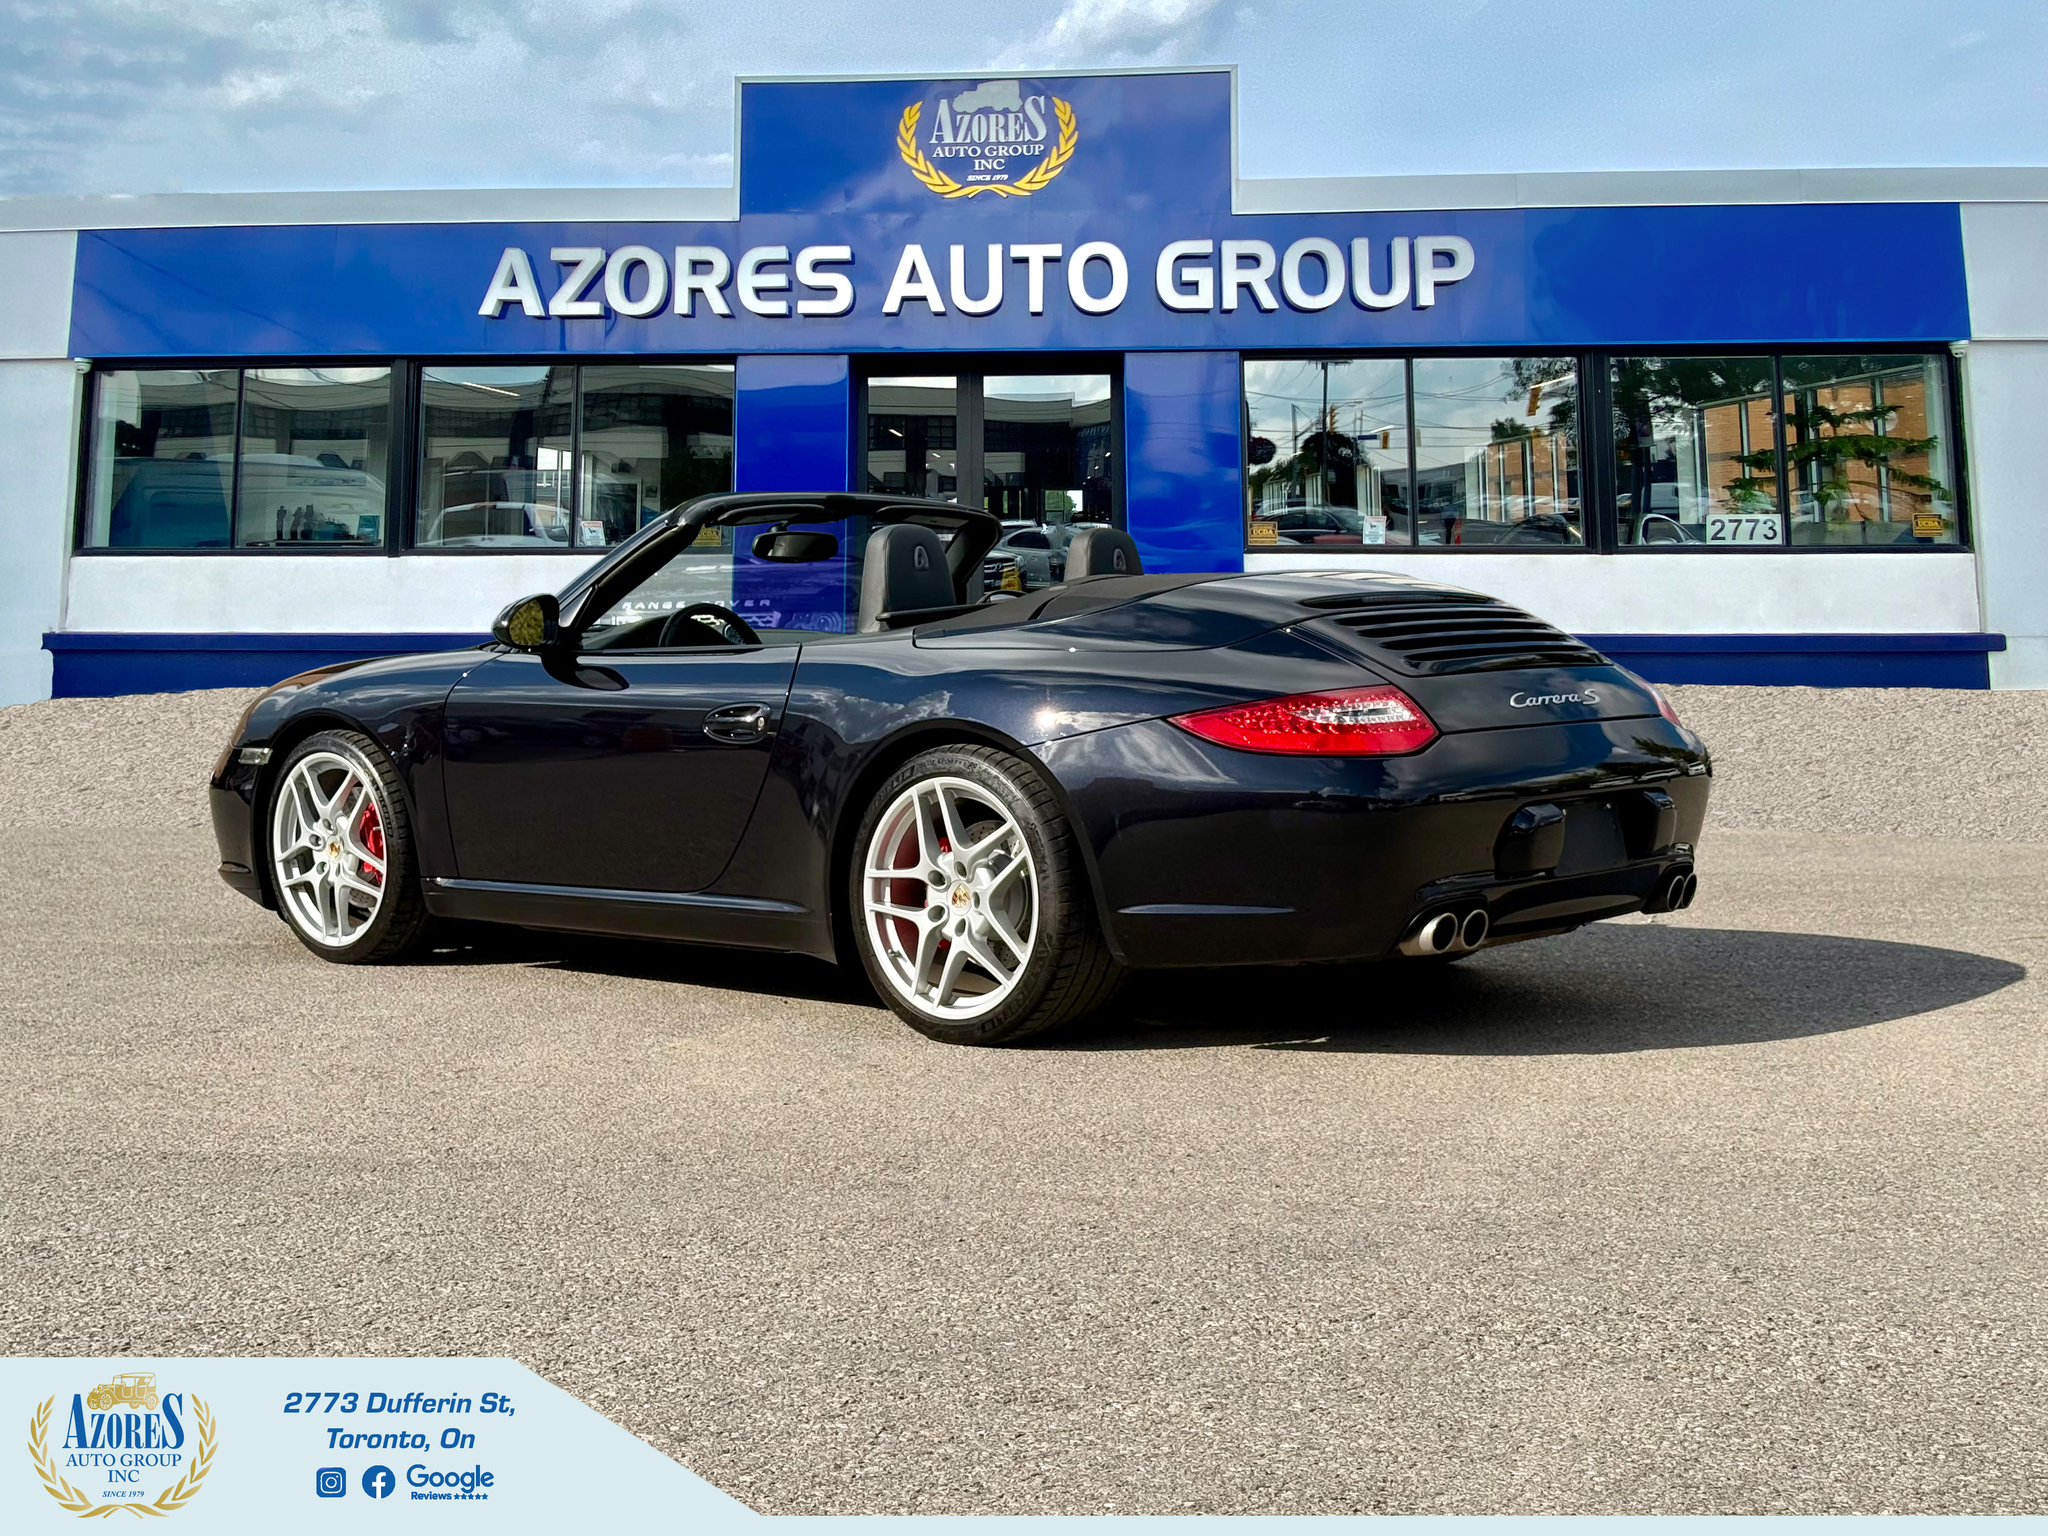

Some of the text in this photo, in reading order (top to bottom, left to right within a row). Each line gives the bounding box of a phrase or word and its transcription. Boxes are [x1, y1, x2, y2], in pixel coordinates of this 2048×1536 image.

[929, 96, 1047, 144] AZORES
[932, 144, 1045, 158] AUTO GROUP
[973, 159, 1006, 171] INC
[967, 174, 991, 182] SINCE
[478, 235, 1475, 318] AZORES AUTO GROUP
[1710, 518, 1778, 541] 2773
[704, 600, 771, 609] OVER
[1510, 688, 1601, 709] Carrera S
